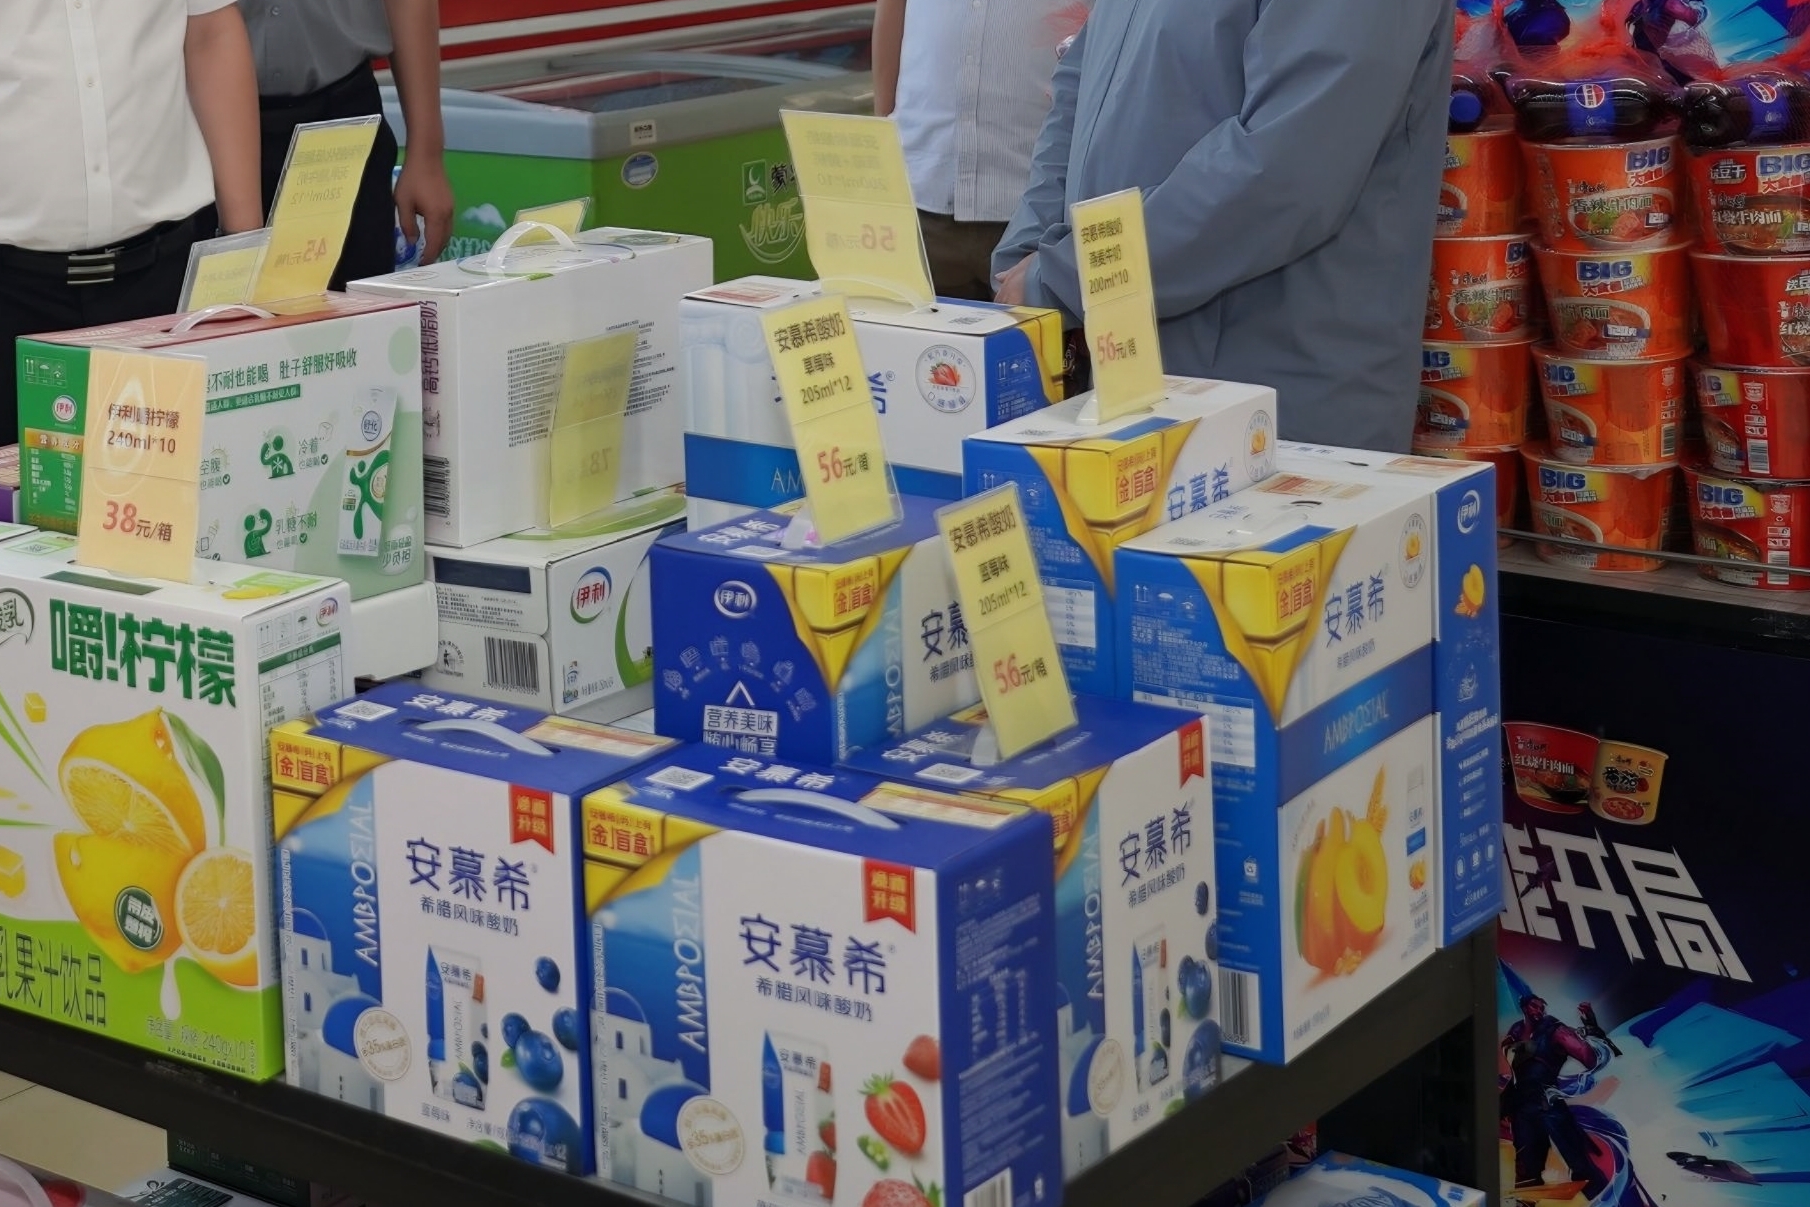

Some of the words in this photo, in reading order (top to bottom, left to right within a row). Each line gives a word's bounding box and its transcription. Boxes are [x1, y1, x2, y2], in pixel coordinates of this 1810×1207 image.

[1626, 145, 1672, 173] BIG
[1577, 260, 1633, 282] BIG
[773, 310, 846, 354] 安慕希酸奶
[278, 347, 358, 380] 肚子舒服好吸收
[1422, 350, 1451, 368] IG
[107, 401, 180, 430] 伊利嚼柠檬
[199, 456, 221, 476] 空腹
[1540, 468, 1586, 491] BIG
[1699, 484, 1745, 506] BIG
[101, 499, 174, 543] 38元/箱
[275, 511, 318, 535] 乳糖不耐
[948, 503, 1017, 554] 安慕希酸奶
[575, 580, 606, 610] 伊利
[717, 589, 750, 608] 伊利
[1324, 569, 1386, 649] 安慕希
[705, 708, 774, 734] 营养美味
[1119, 800, 1192, 888] 安慕希
[404, 836, 532, 913] 安慕希
[419, 894, 520, 938] 希腊风味酸奶
[737, 913, 888, 996] 安慕希
[754, 976, 876, 1023] 希腊风味酸奶
